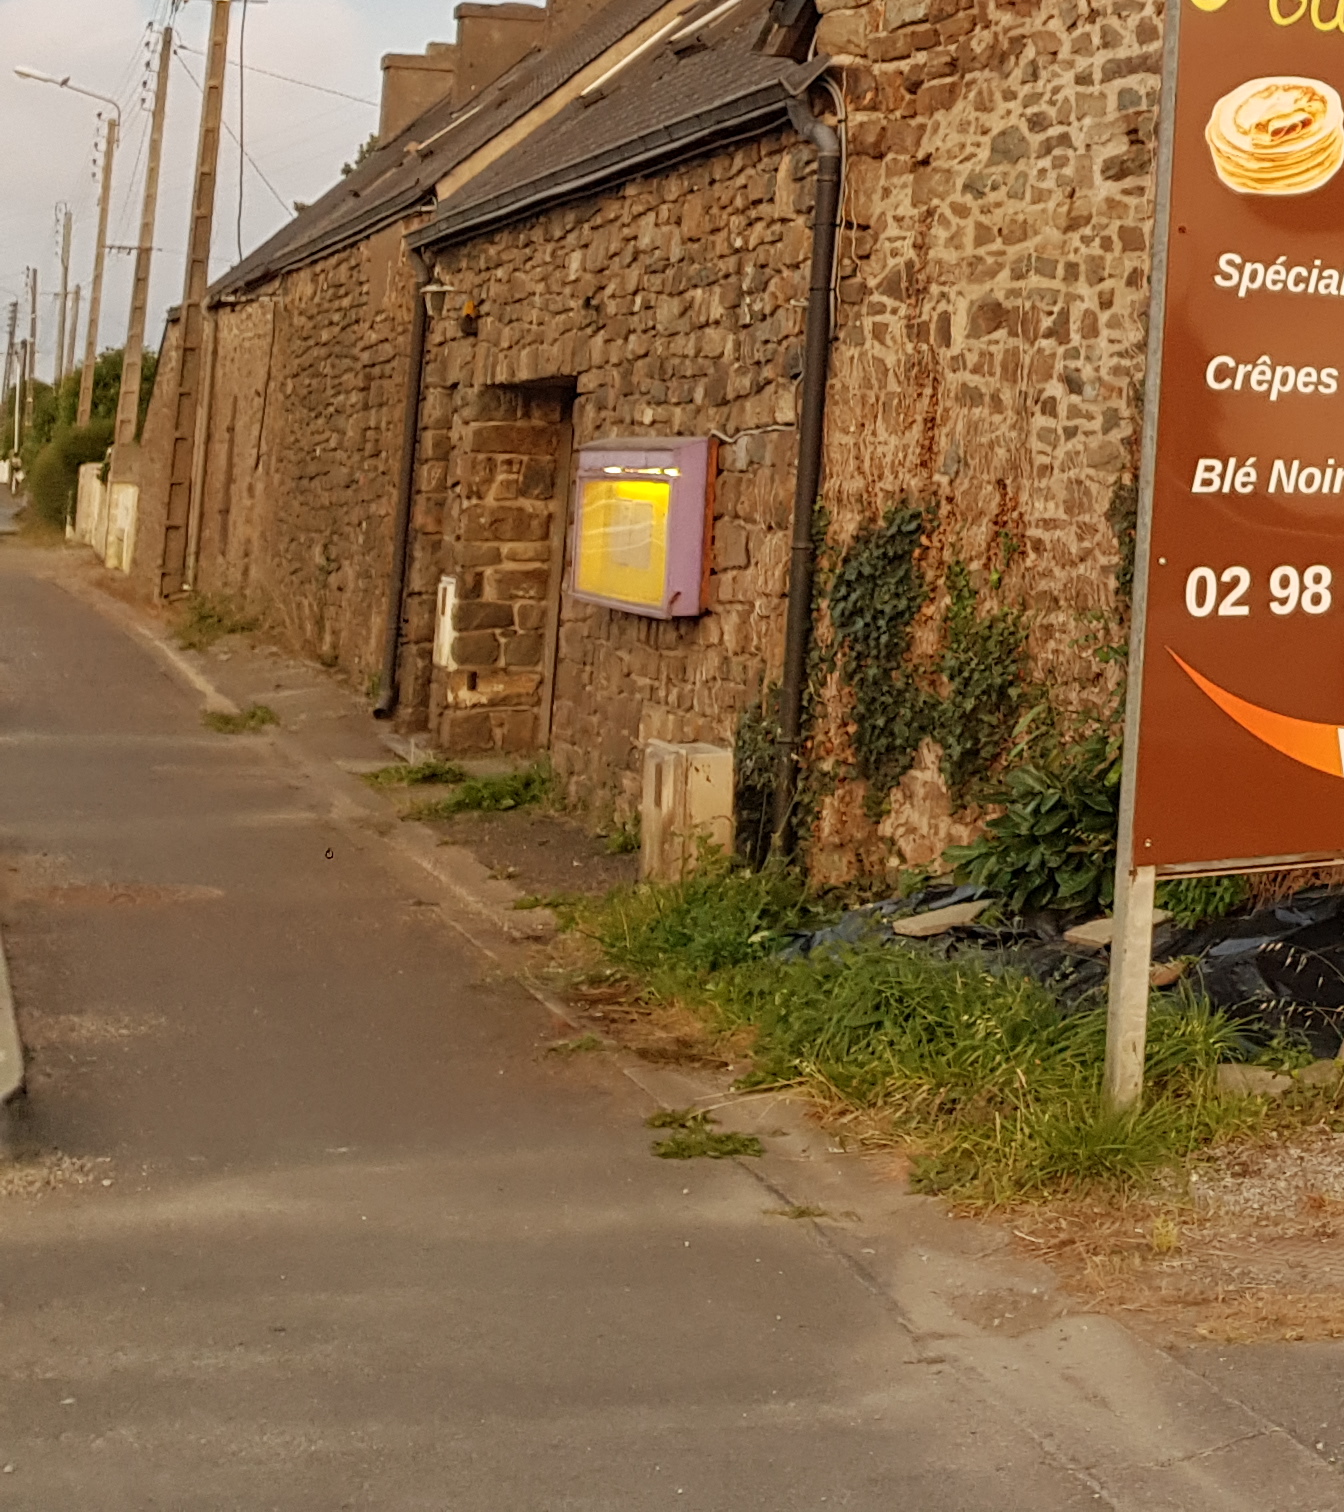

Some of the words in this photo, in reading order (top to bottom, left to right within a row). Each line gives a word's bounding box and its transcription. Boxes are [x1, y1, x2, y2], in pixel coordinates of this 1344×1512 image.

[1205, 355, 1339, 401] Crêpes
[1191, 457, 1258, 494] Blé
[1184, 566, 1251, 617] 02
[1268, 565, 1332, 615] 98
